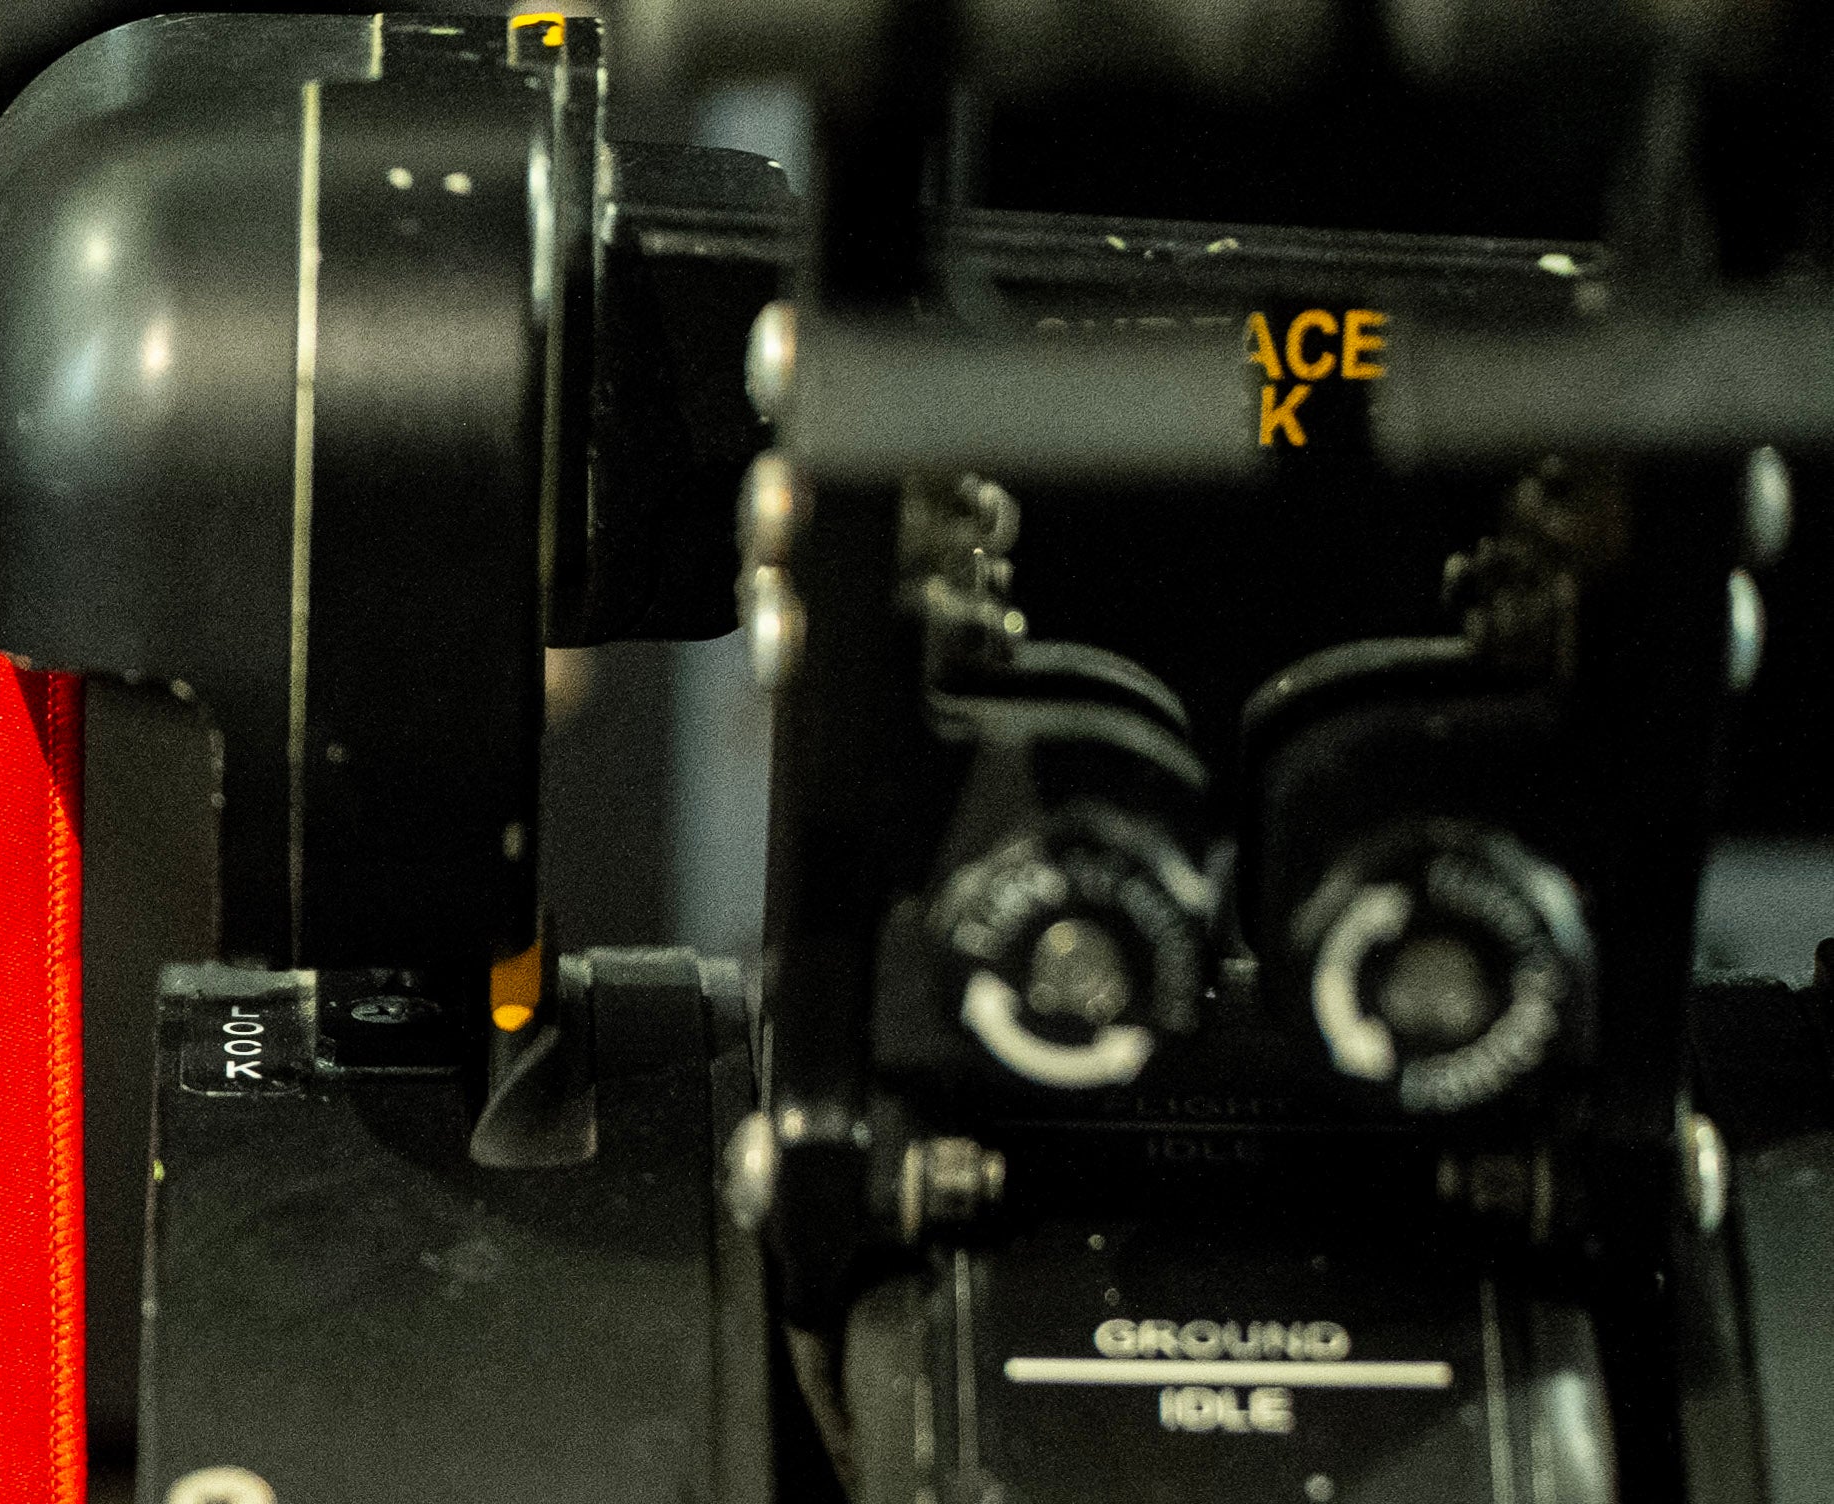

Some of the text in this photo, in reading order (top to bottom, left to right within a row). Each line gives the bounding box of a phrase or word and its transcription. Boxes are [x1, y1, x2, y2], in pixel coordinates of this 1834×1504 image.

[222, 1005, 265, 1079] LOCK
[1093, 1318, 1351, 1361] GROUND
[1159, 1386, 1295, 1433] IDLE
